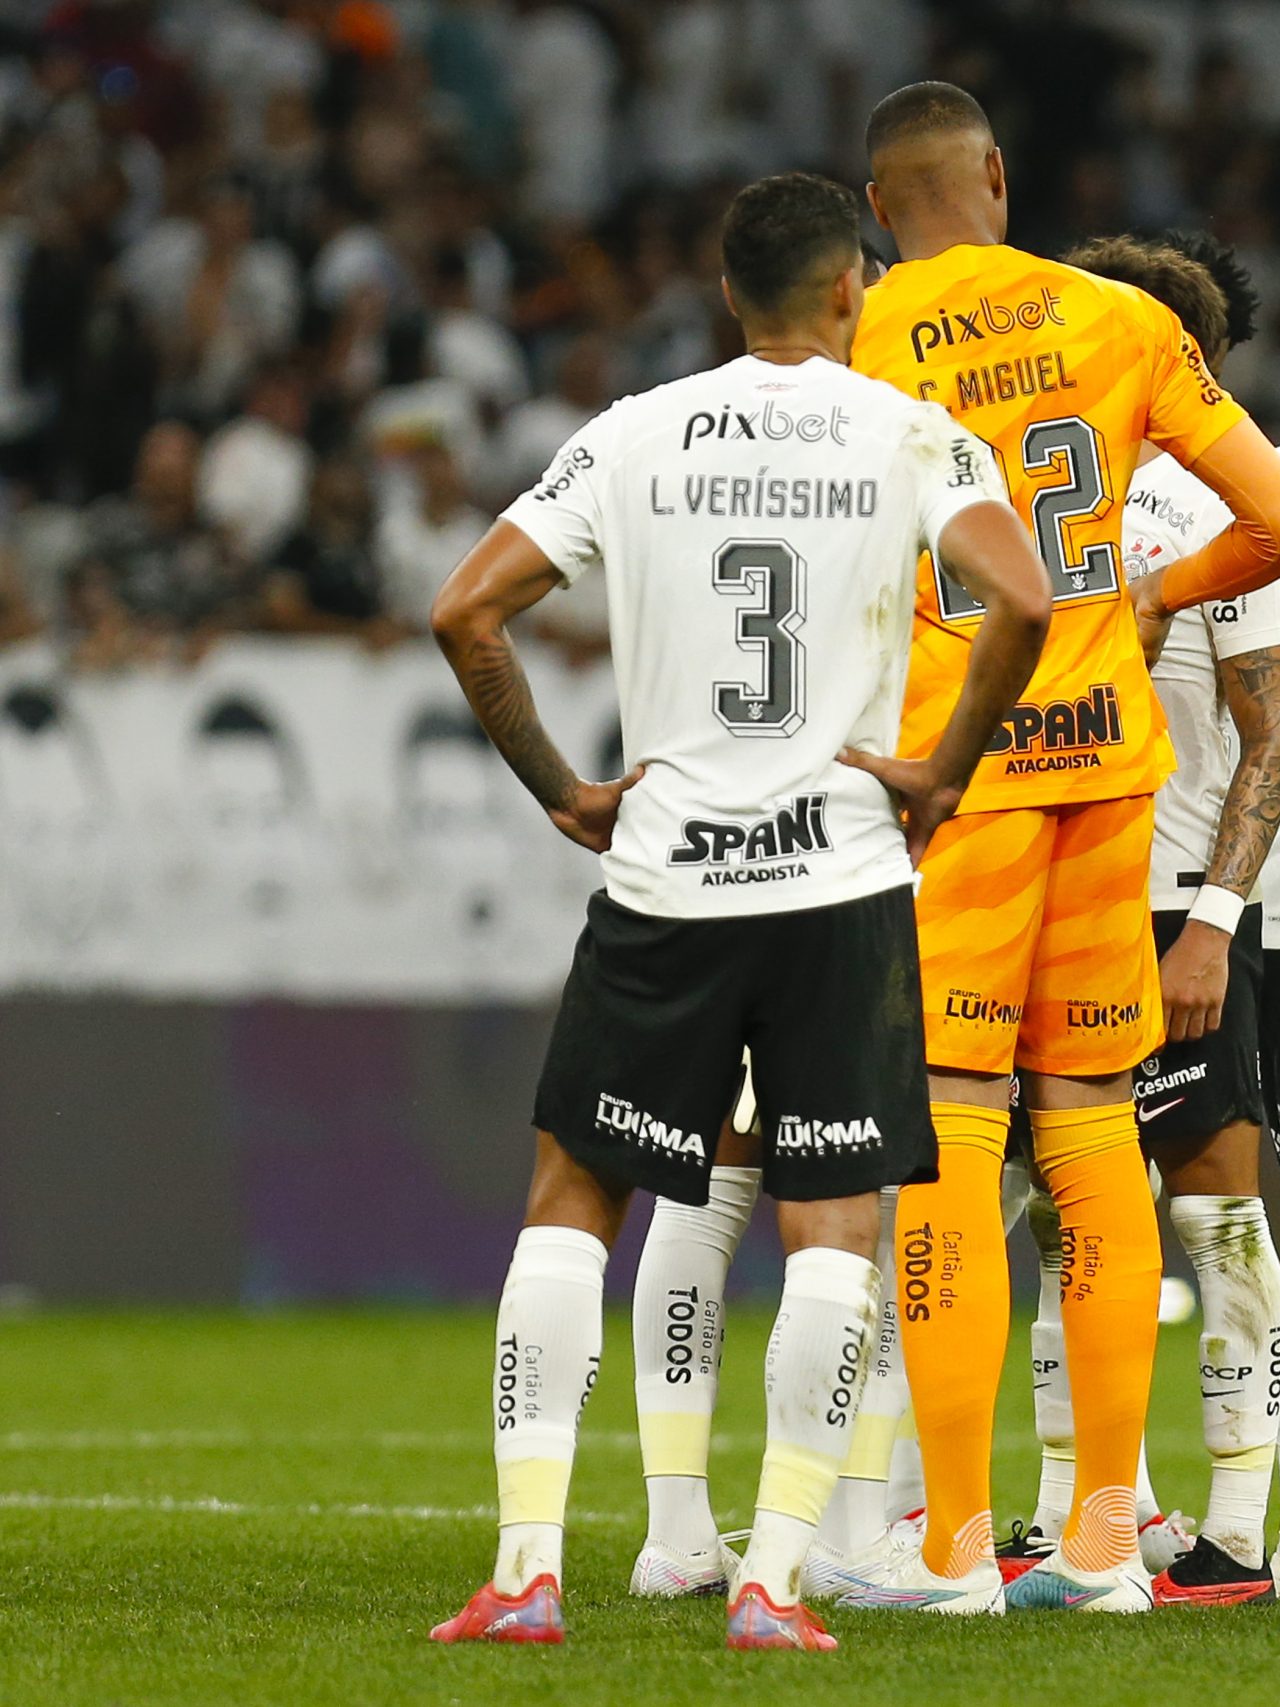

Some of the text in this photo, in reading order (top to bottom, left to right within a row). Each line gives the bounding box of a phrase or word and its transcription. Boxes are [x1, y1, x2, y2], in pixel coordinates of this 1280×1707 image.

[910, 287, 1066, 363] pixbet
[955, 351, 1077, 410] MIGUEL
[682, 400, 850, 450] pixbet
[650, 465, 878, 518] L. VERÍSSIMO
[1125, 489, 1195, 537] pixbet
[712, 537, 808, 738] 3
[1005, 752, 1101, 774] ATACADISTA
[701, 862, 810, 887] ATACADISTA
[949, 988, 981, 1000] GRUPO
[1067, 999, 1099, 1008] GRUPO
[600, 1092, 633, 1110] GRUPO
[776, 1116, 882, 1149] LUKMA
[904, 1222, 934, 1322] TODOS
[939, 1231, 963, 1308] Cartão de
[1073, 1235, 1103, 1302] Cartão de
[666, 1285, 699, 1384] TODOS
[700, 1300, 720, 1375] Cartão de
[498, 1332, 519, 1430] TODOS
[525, 1345, 543, 1419] Cartão de
[826, 1326, 866, 1428] TODOS
[876, 1359, 892, 1377] de
[1199, 1363, 1253, 1380] CCP
